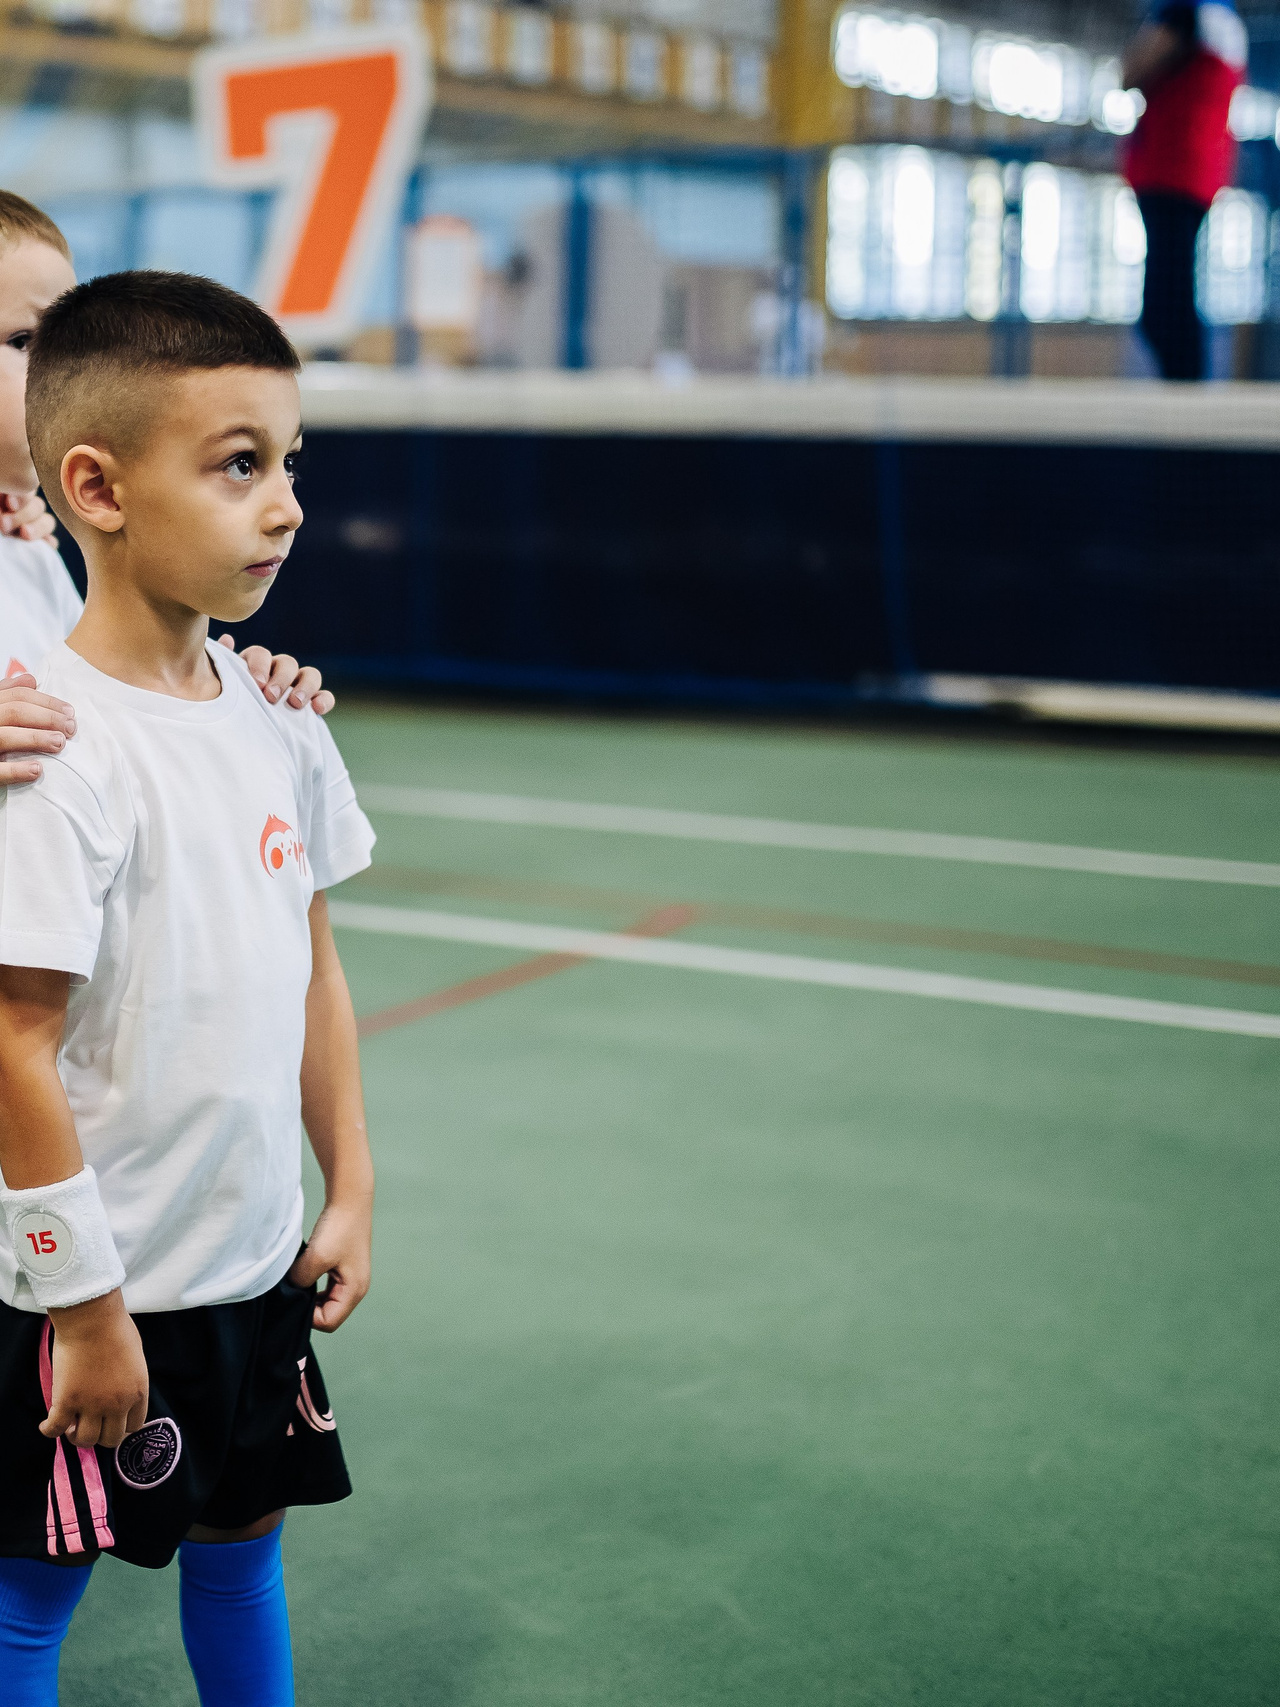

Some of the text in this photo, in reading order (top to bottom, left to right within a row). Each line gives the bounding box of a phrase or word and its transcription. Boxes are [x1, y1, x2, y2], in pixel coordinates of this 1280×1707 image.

[227, 53, 398, 315] 7
[26, 1230, 57, 1255] 15
[145, 1440, 167, 1449] MIAMI
